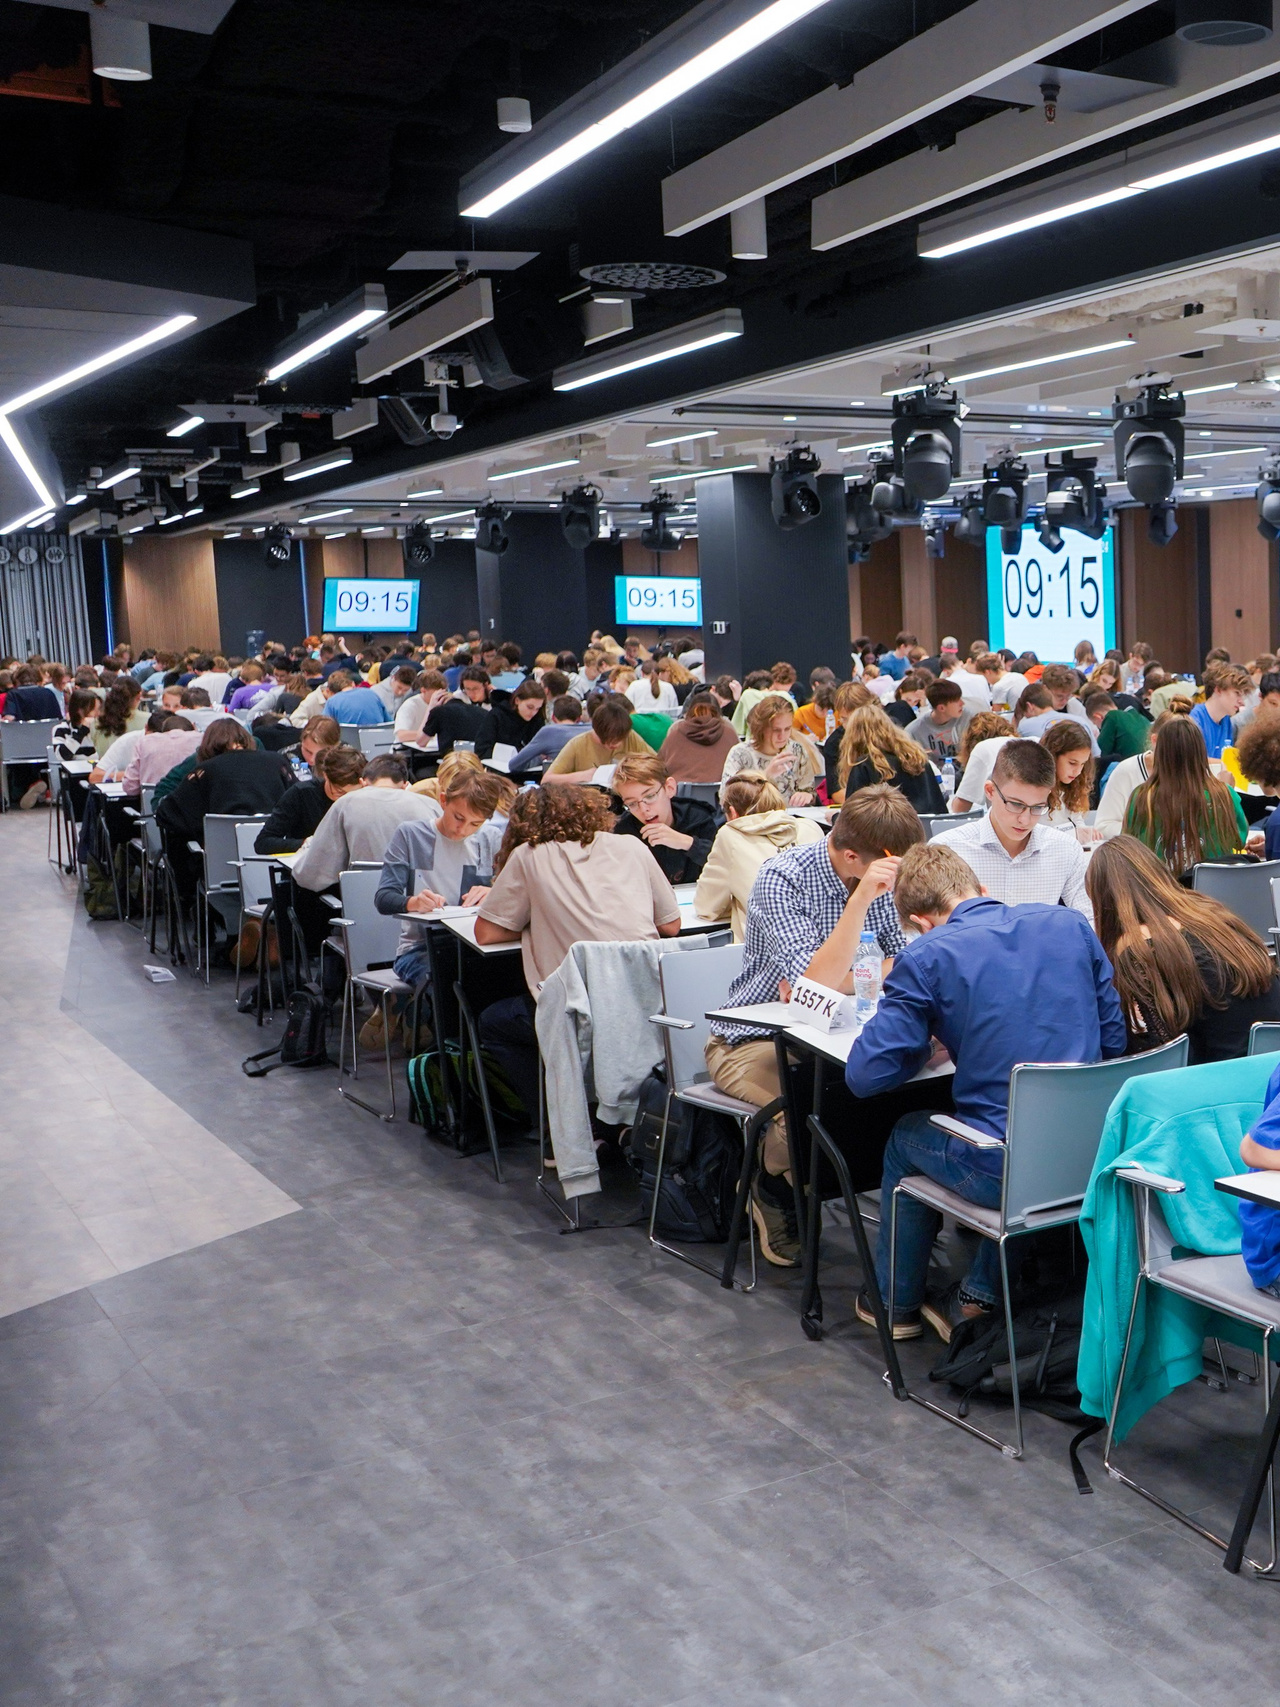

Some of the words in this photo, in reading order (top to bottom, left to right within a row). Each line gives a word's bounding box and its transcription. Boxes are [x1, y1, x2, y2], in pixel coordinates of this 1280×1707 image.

[628, 587, 695, 608] 09:15
[1005, 556, 1099, 618] 09:15
[338, 590, 410, 613] 09:15
[794, 986, 825, 1011] 1557
